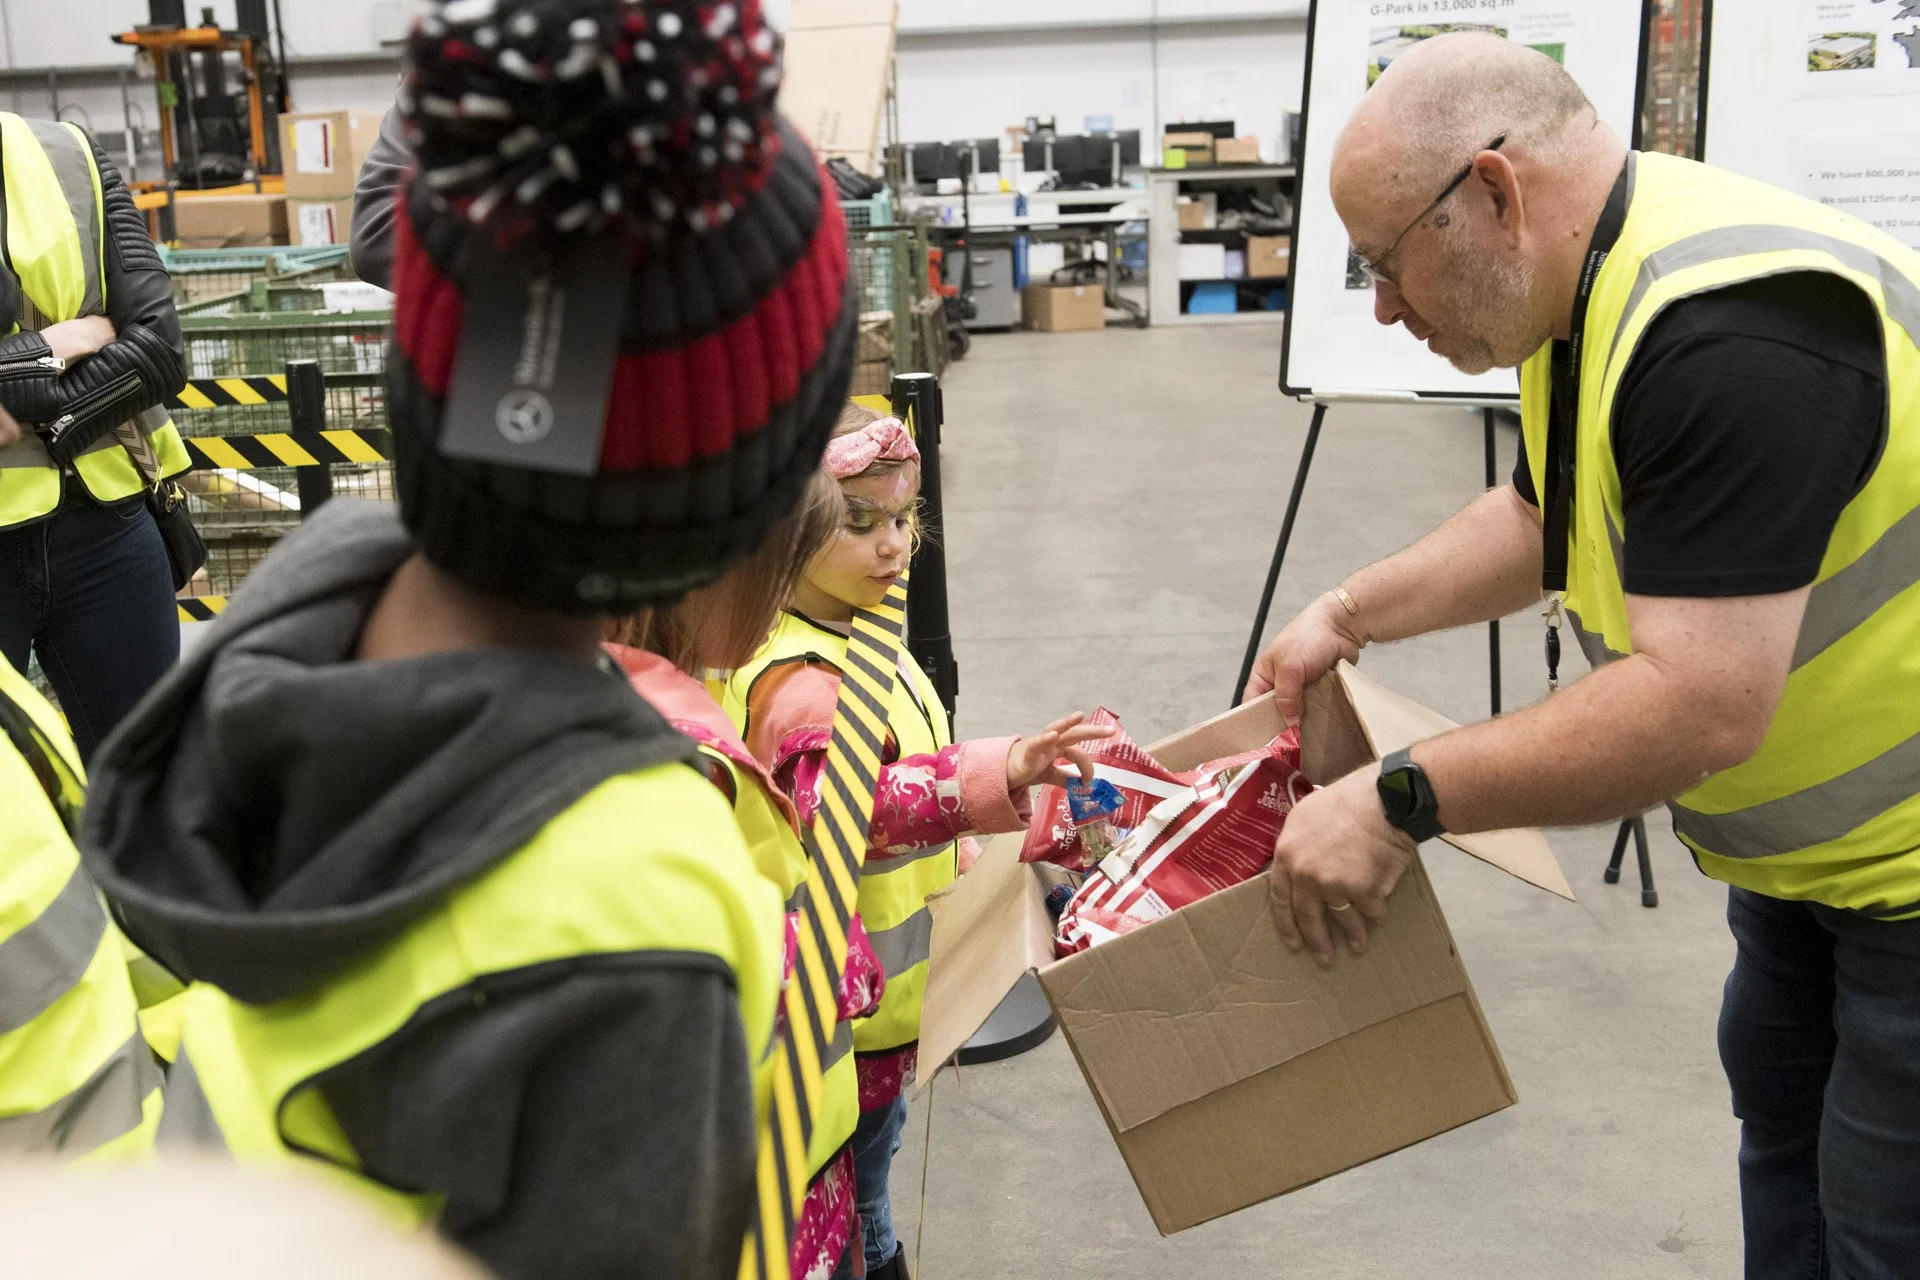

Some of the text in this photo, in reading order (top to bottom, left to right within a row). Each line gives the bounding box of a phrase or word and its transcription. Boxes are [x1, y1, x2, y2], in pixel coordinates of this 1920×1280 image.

[1370, 3, 1414, 16] G-Park
[1417, 3, 1429, 12] is
[1433, 0, 1476, 12] 13,000
[1821, 171, 1837, 179] We
[1839, 171, 1863, 179] have
[1820, 196, 1836, 204] We
[1838, 195, 1859, 203] sold
[1898, 194, 1909, 202] of
[1885, 219, 1897, 227] 92
